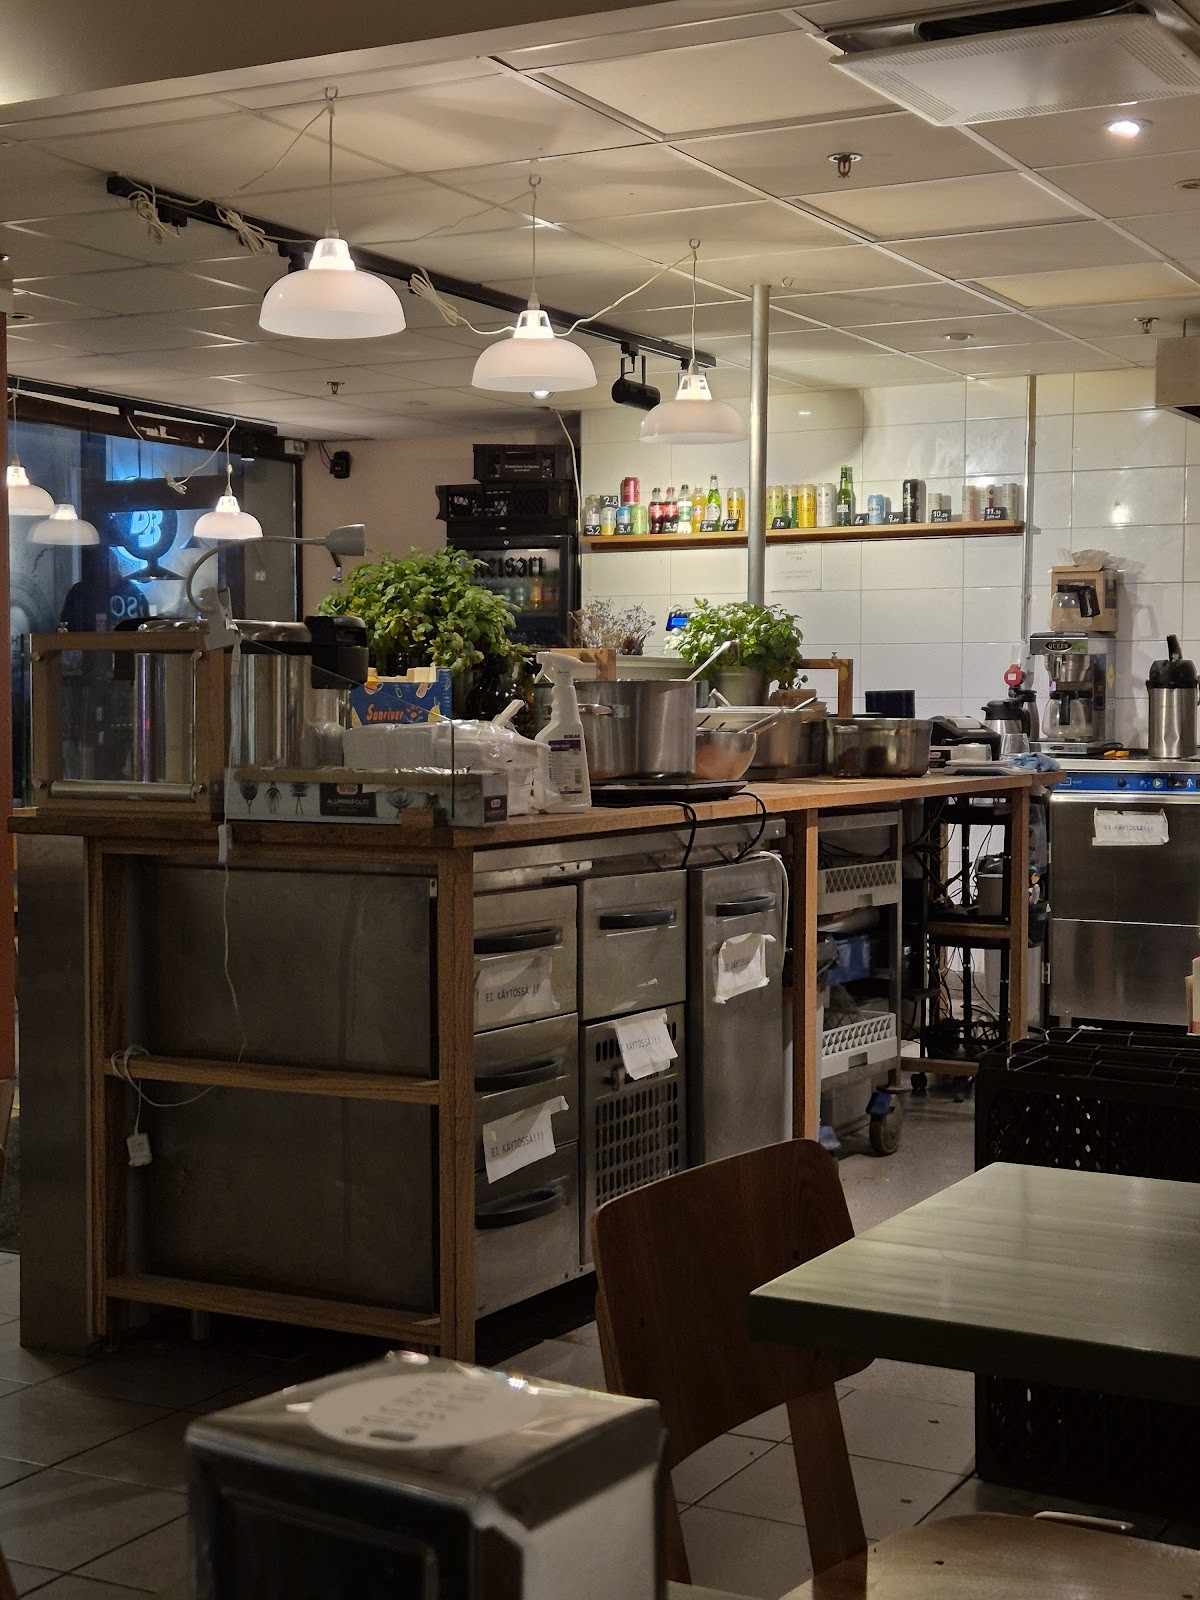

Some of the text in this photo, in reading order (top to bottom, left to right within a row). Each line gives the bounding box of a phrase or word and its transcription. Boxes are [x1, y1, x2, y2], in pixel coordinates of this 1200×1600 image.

[603, 496, 618, 506] 2.8
[585, 525, 601, 535] 3.2
[1049, 642, 1069, 650] QUEEN
[485, 992, 493, 1003] EI
[491, 1147, 500, 1158] EI
